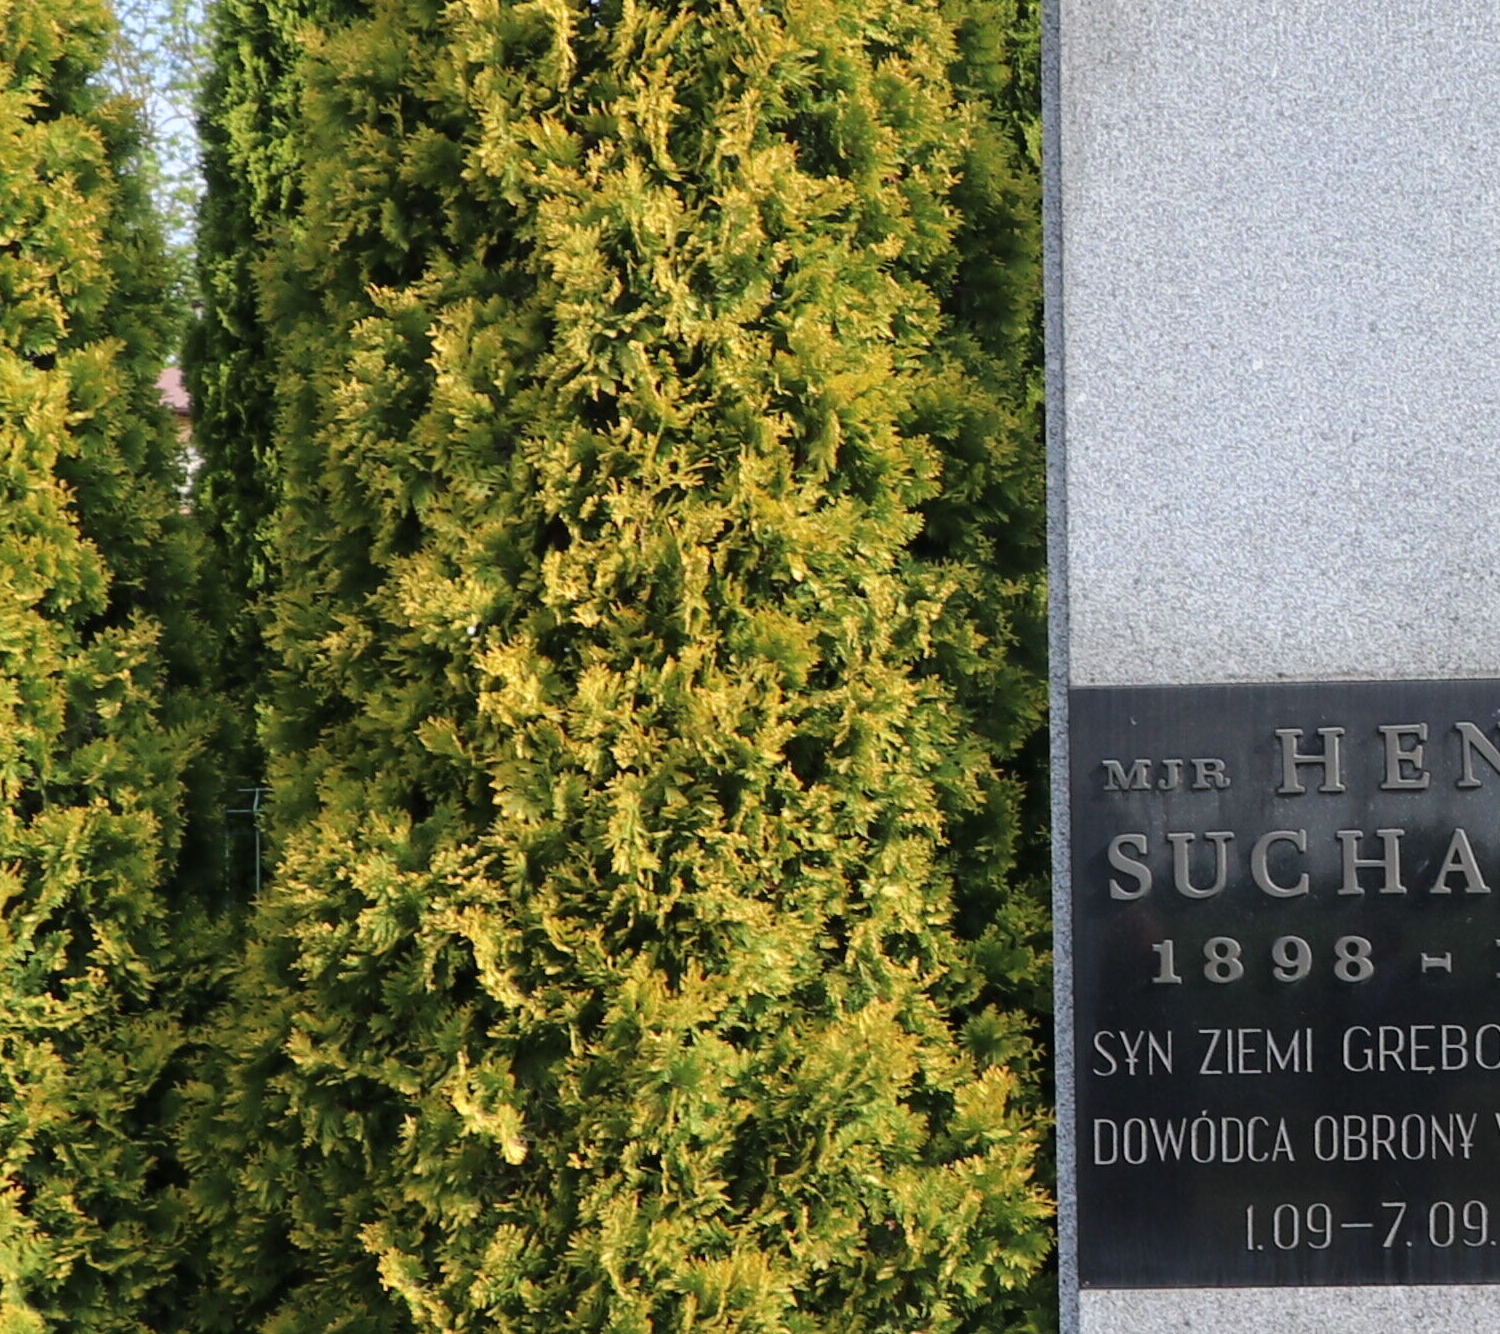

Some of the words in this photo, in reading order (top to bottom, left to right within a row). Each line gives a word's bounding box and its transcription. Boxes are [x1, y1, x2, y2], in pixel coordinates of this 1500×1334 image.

[1101, 757, 1232, 792] MJR
[1151, 934, 1376, 985] 1898
[1092, 1029, 1174, 1078] SYN
[1197, 1026, 1314, 1076] ZIEMI
[1092, 1109, 1297, 1166] DOWÓDCA
[1313, 1113, 1479, 1162] OBRONY
